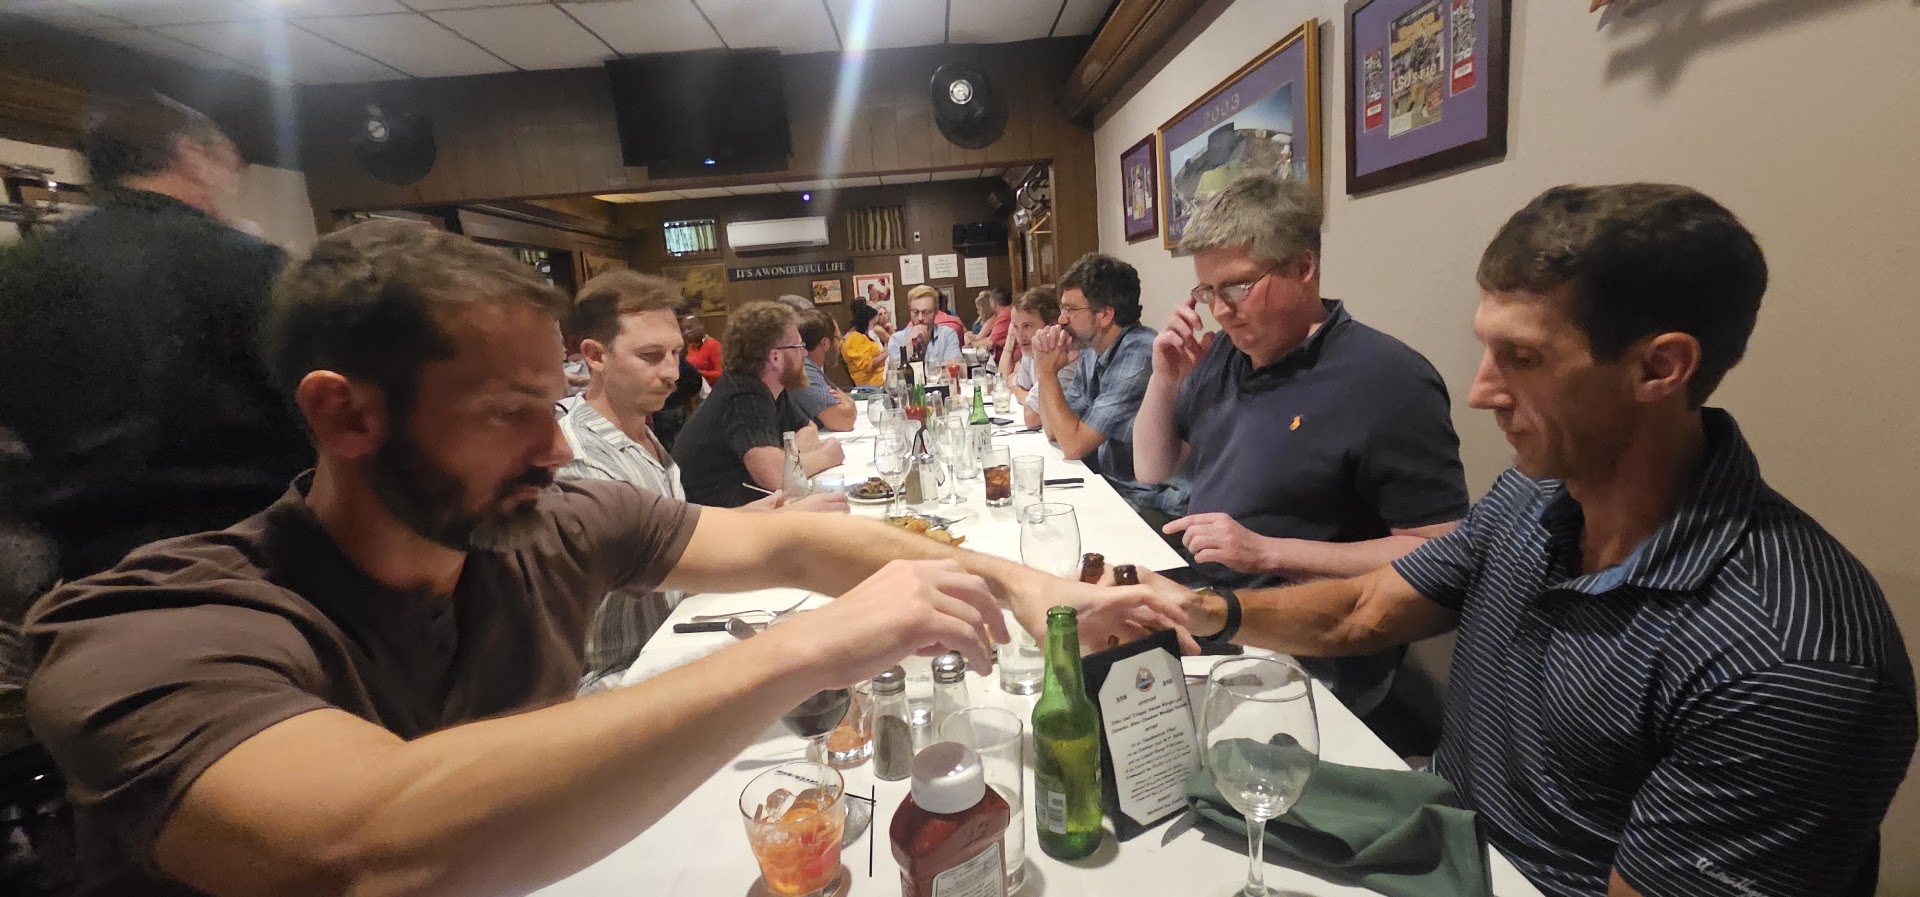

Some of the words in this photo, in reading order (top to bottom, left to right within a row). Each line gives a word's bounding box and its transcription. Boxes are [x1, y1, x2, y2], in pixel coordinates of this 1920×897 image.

[1202, 92, 1240, 129] 2003
[736, 269, 753, 279] IT'S
[762, 263, 824, 276] WONDERFUL
[825, 262, 846, 272] LIFE
